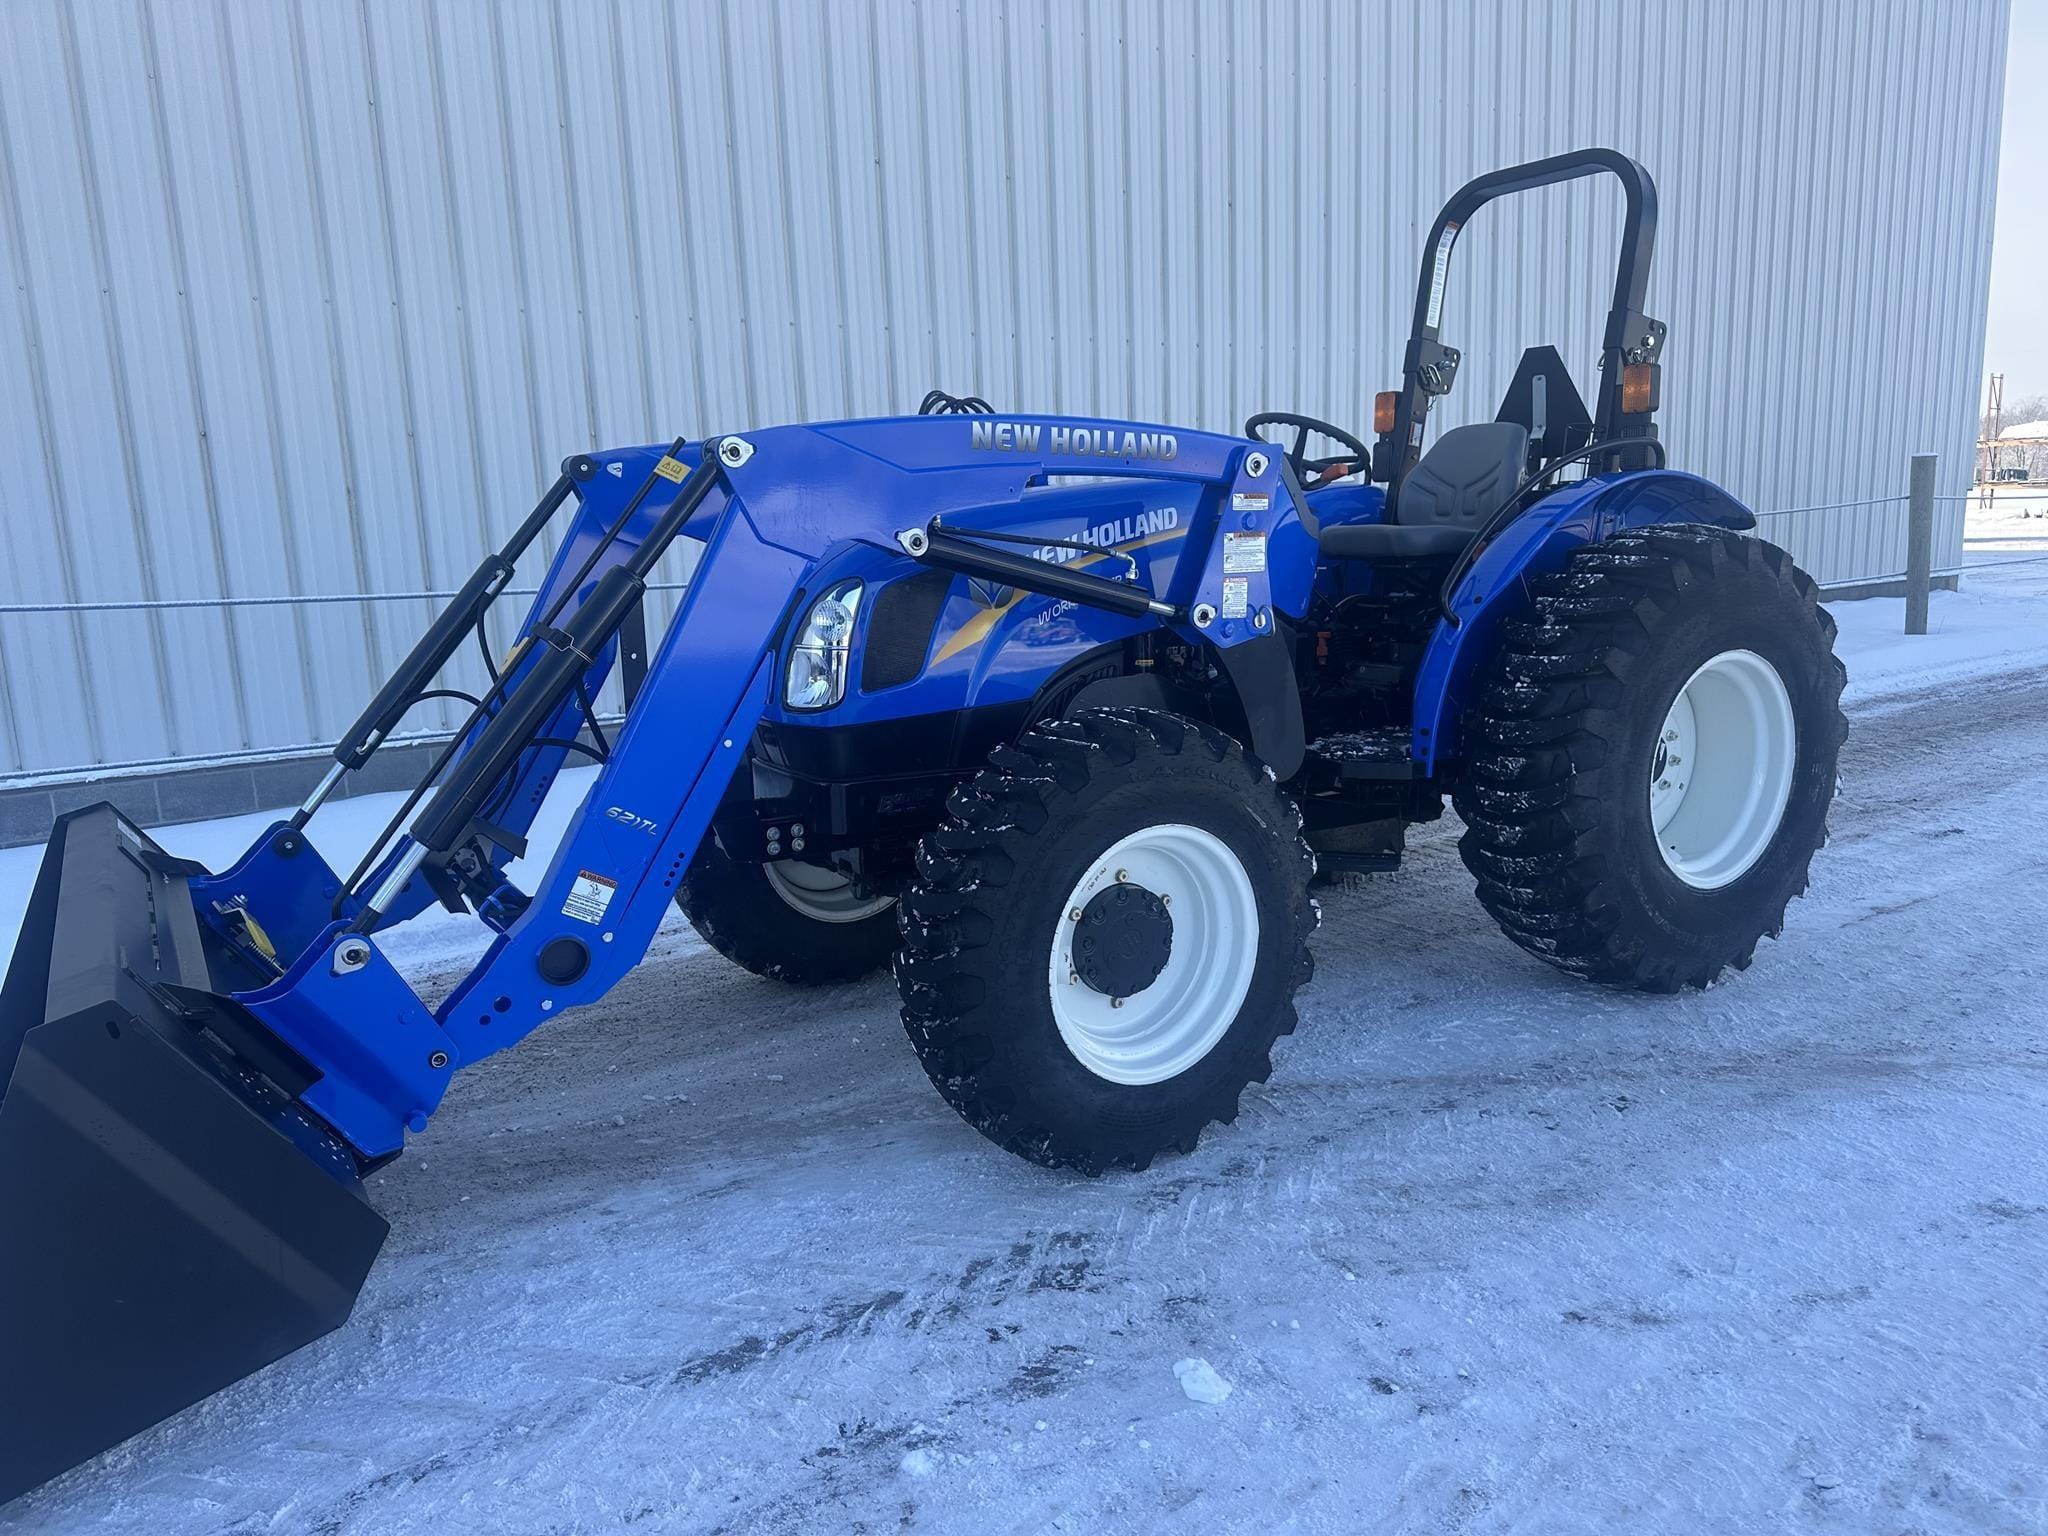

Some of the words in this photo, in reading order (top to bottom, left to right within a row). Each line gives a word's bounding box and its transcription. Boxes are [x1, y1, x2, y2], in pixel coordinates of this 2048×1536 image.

[971, 420, 1041, 454] NEW
[1050, 426, 1178, 461] HOLLAND
[1026, 533, 1079, 565] EW
[1082, 507, 1178, 553] HOLLAND
[606, 806, 658, 836] 621TL
[586, 873, 617, 889] WARNING
